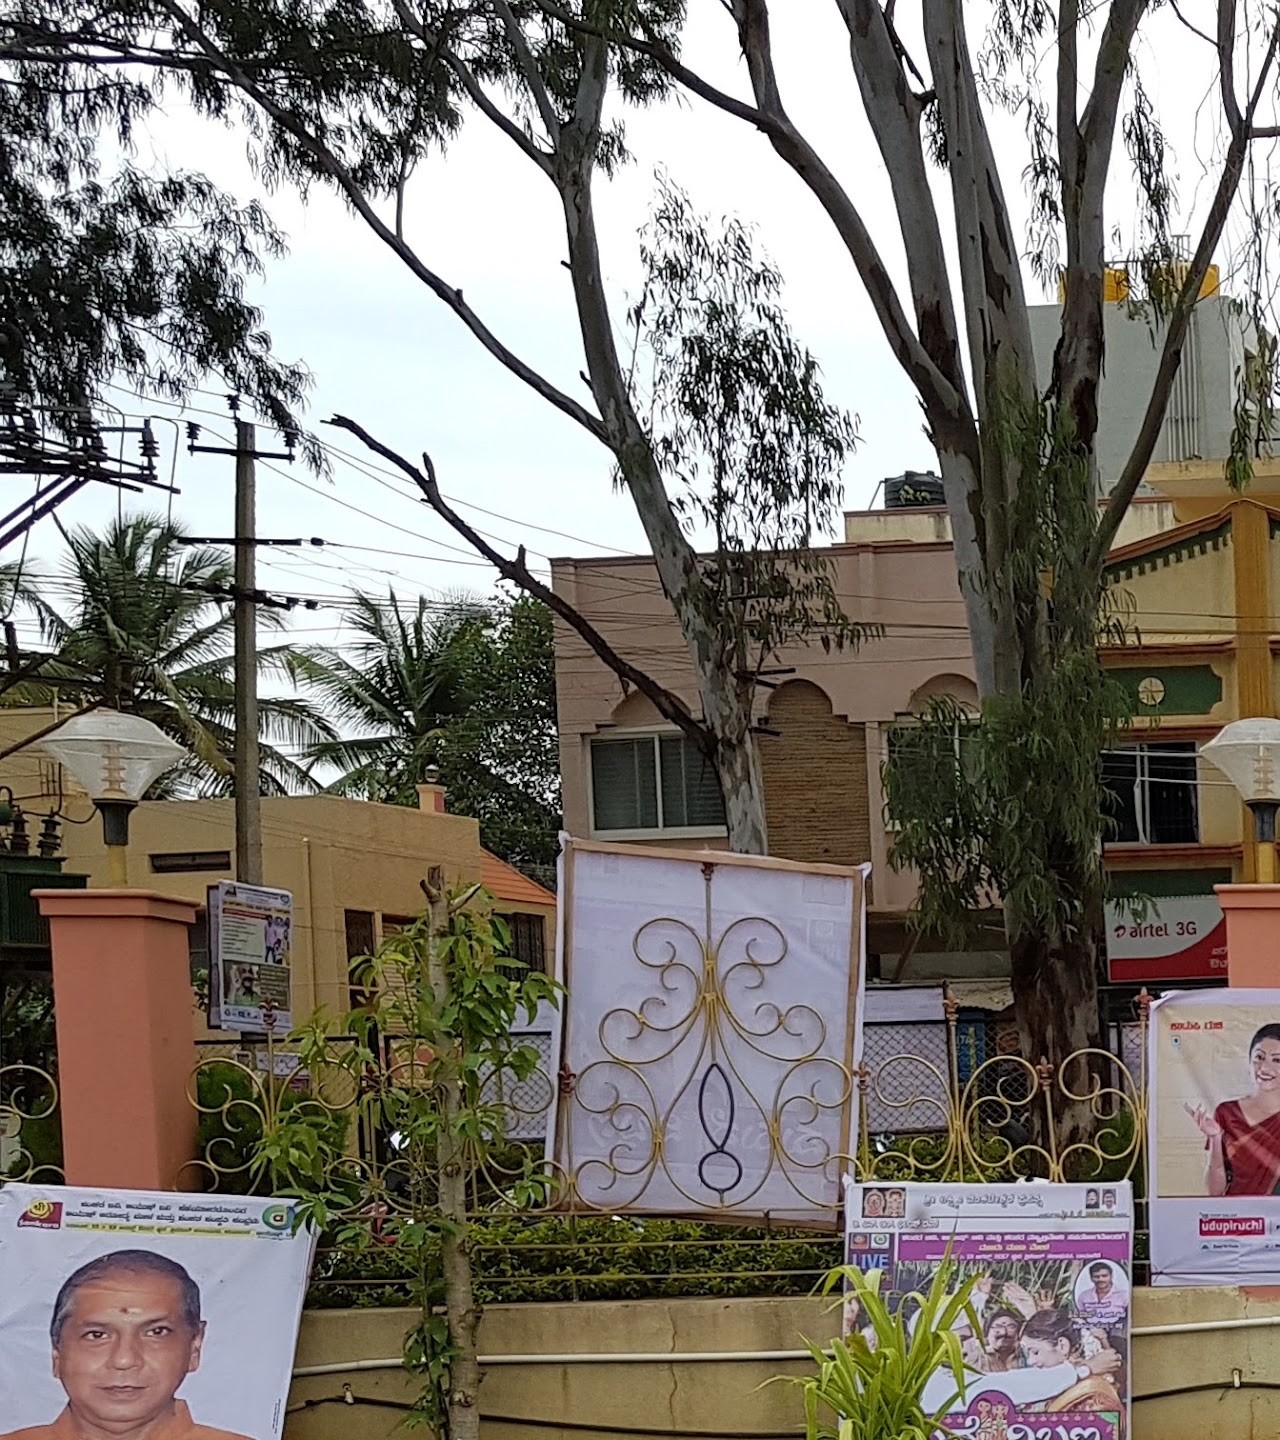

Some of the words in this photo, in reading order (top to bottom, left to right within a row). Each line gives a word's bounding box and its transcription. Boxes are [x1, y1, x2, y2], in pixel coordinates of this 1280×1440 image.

[1129, 922, 1169, 937] airtel
[1176, 922, 1197, 937] 3G
[852, 1253, 890, 1270] LIVE
